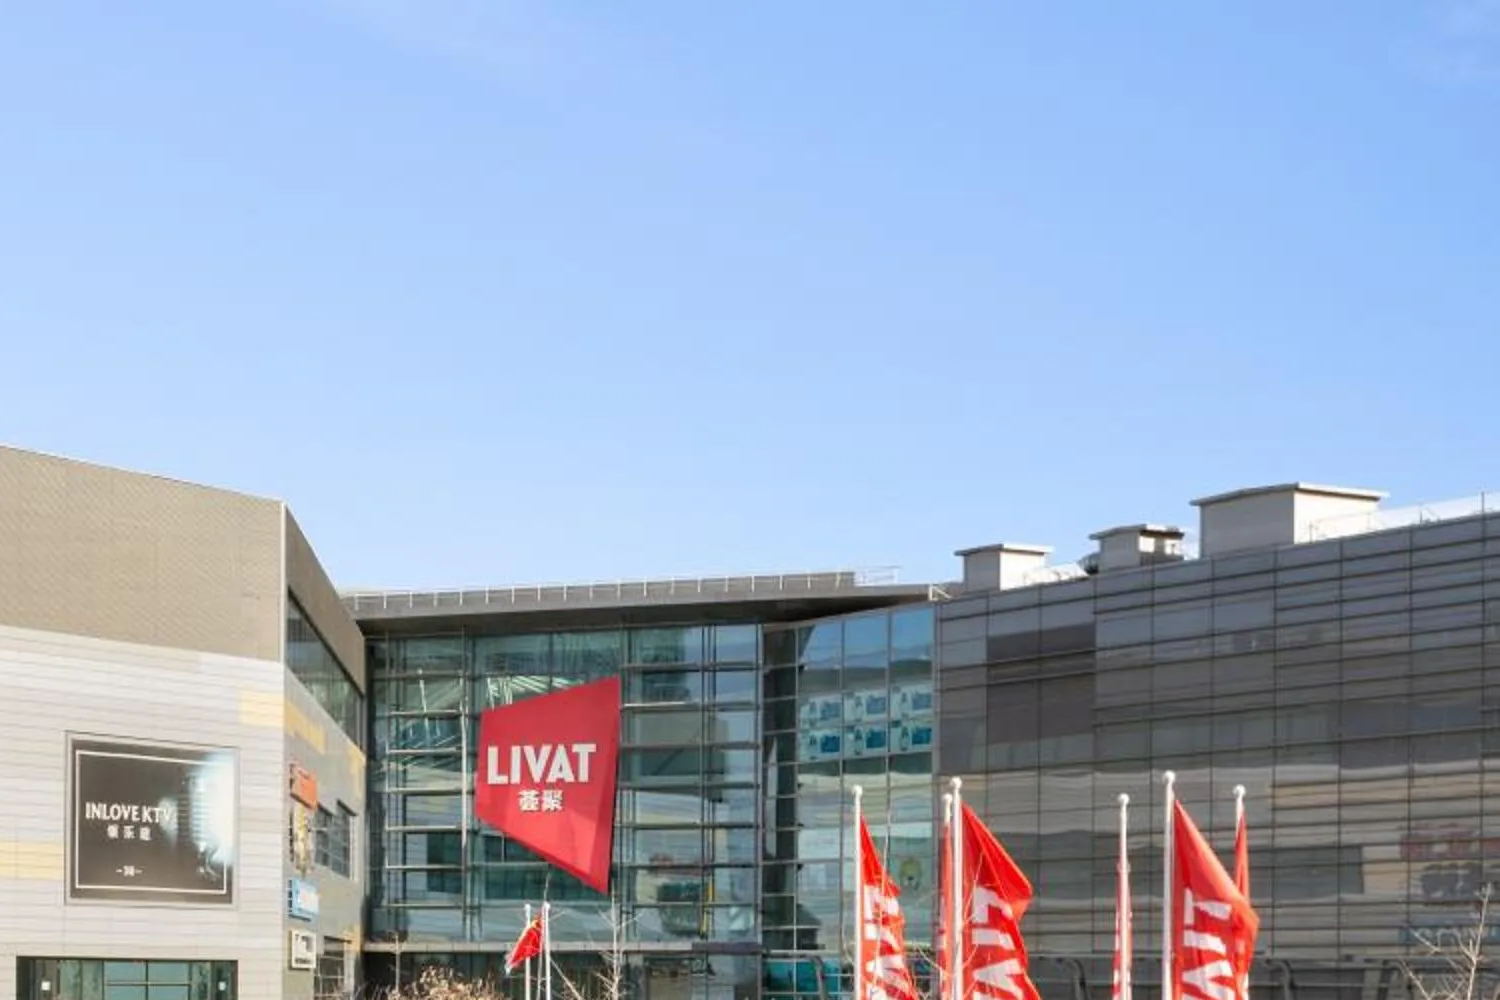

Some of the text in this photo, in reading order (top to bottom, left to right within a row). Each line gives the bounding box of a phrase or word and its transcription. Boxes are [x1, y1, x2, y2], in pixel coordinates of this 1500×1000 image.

[487, 743, 597, 785] LIVAT
[85, 801, 174, 823] INLOVE KTV
